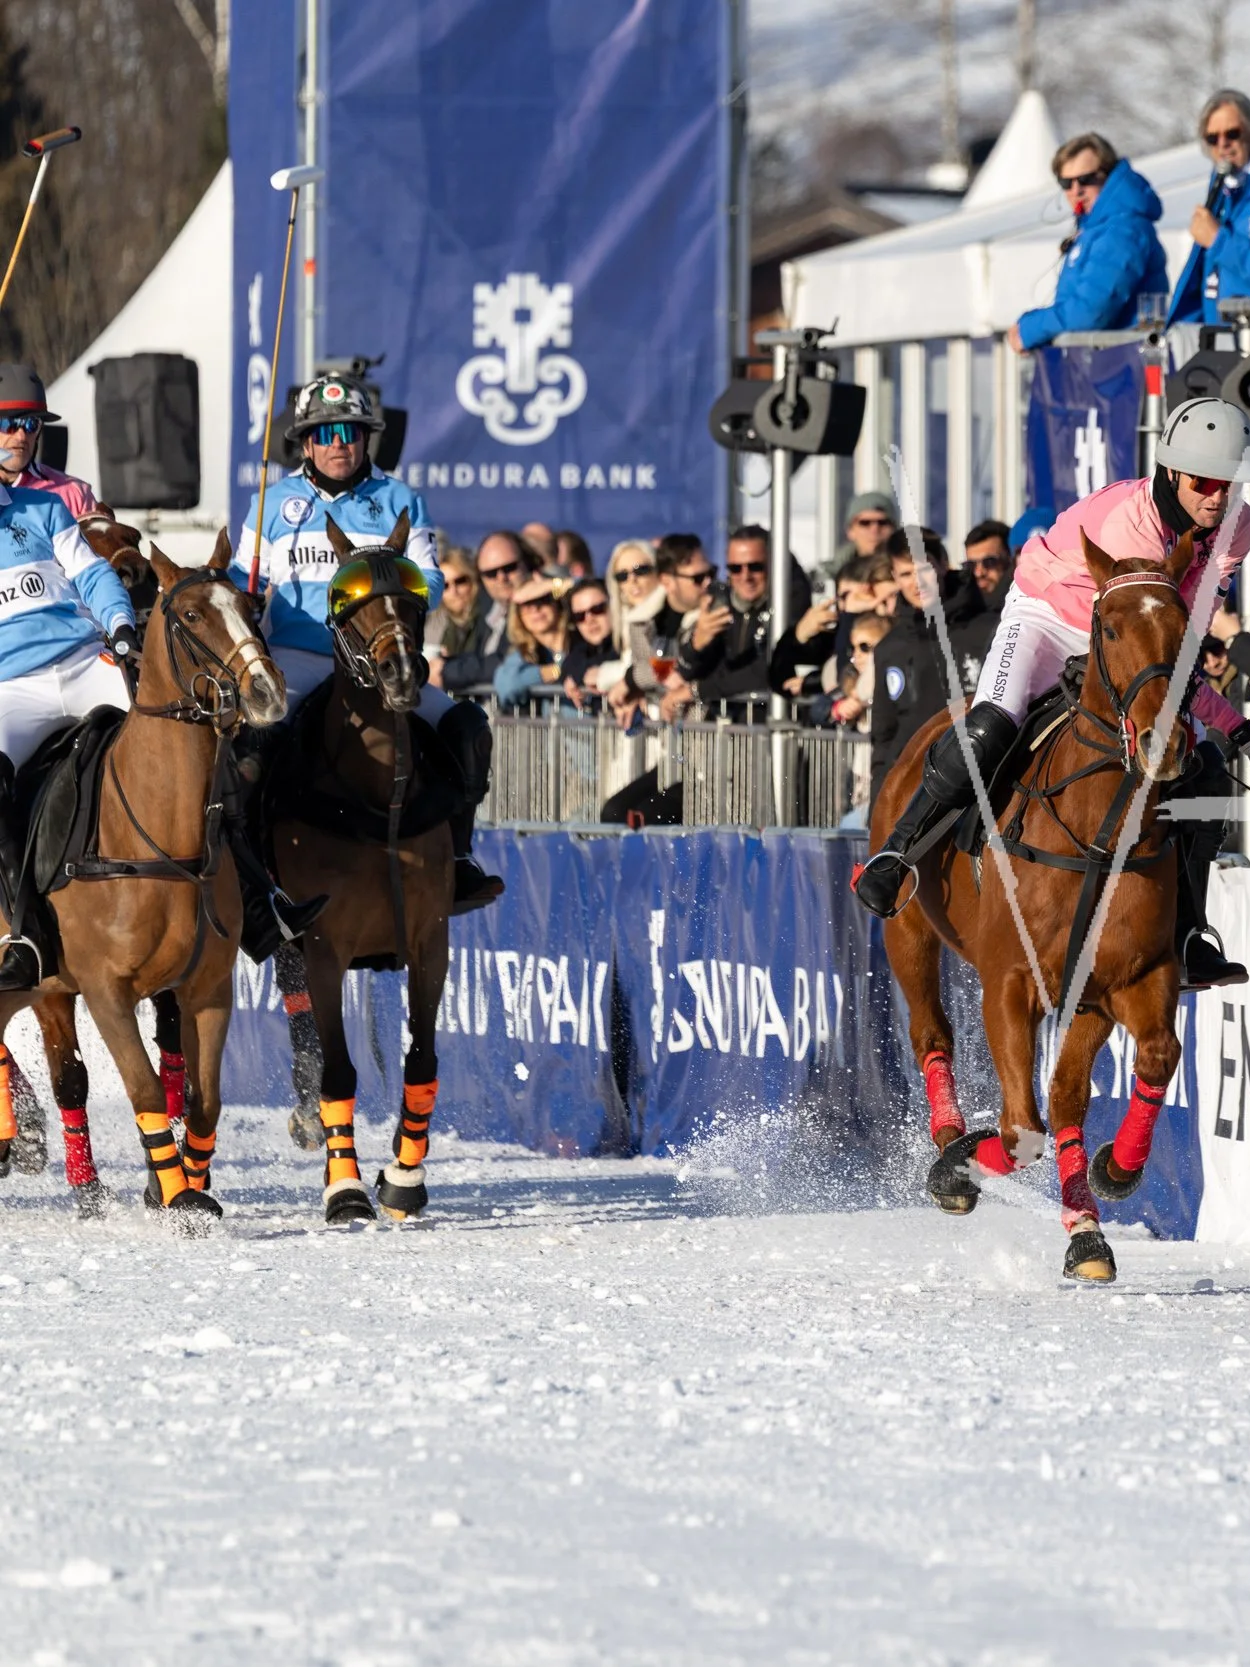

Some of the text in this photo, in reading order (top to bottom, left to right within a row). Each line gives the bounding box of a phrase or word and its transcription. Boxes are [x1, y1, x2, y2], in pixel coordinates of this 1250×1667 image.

[561, 463, 657, 490] BANK
[288, 546, 339, 567] Allia
[1000, 642, 1016, 668] POLO
